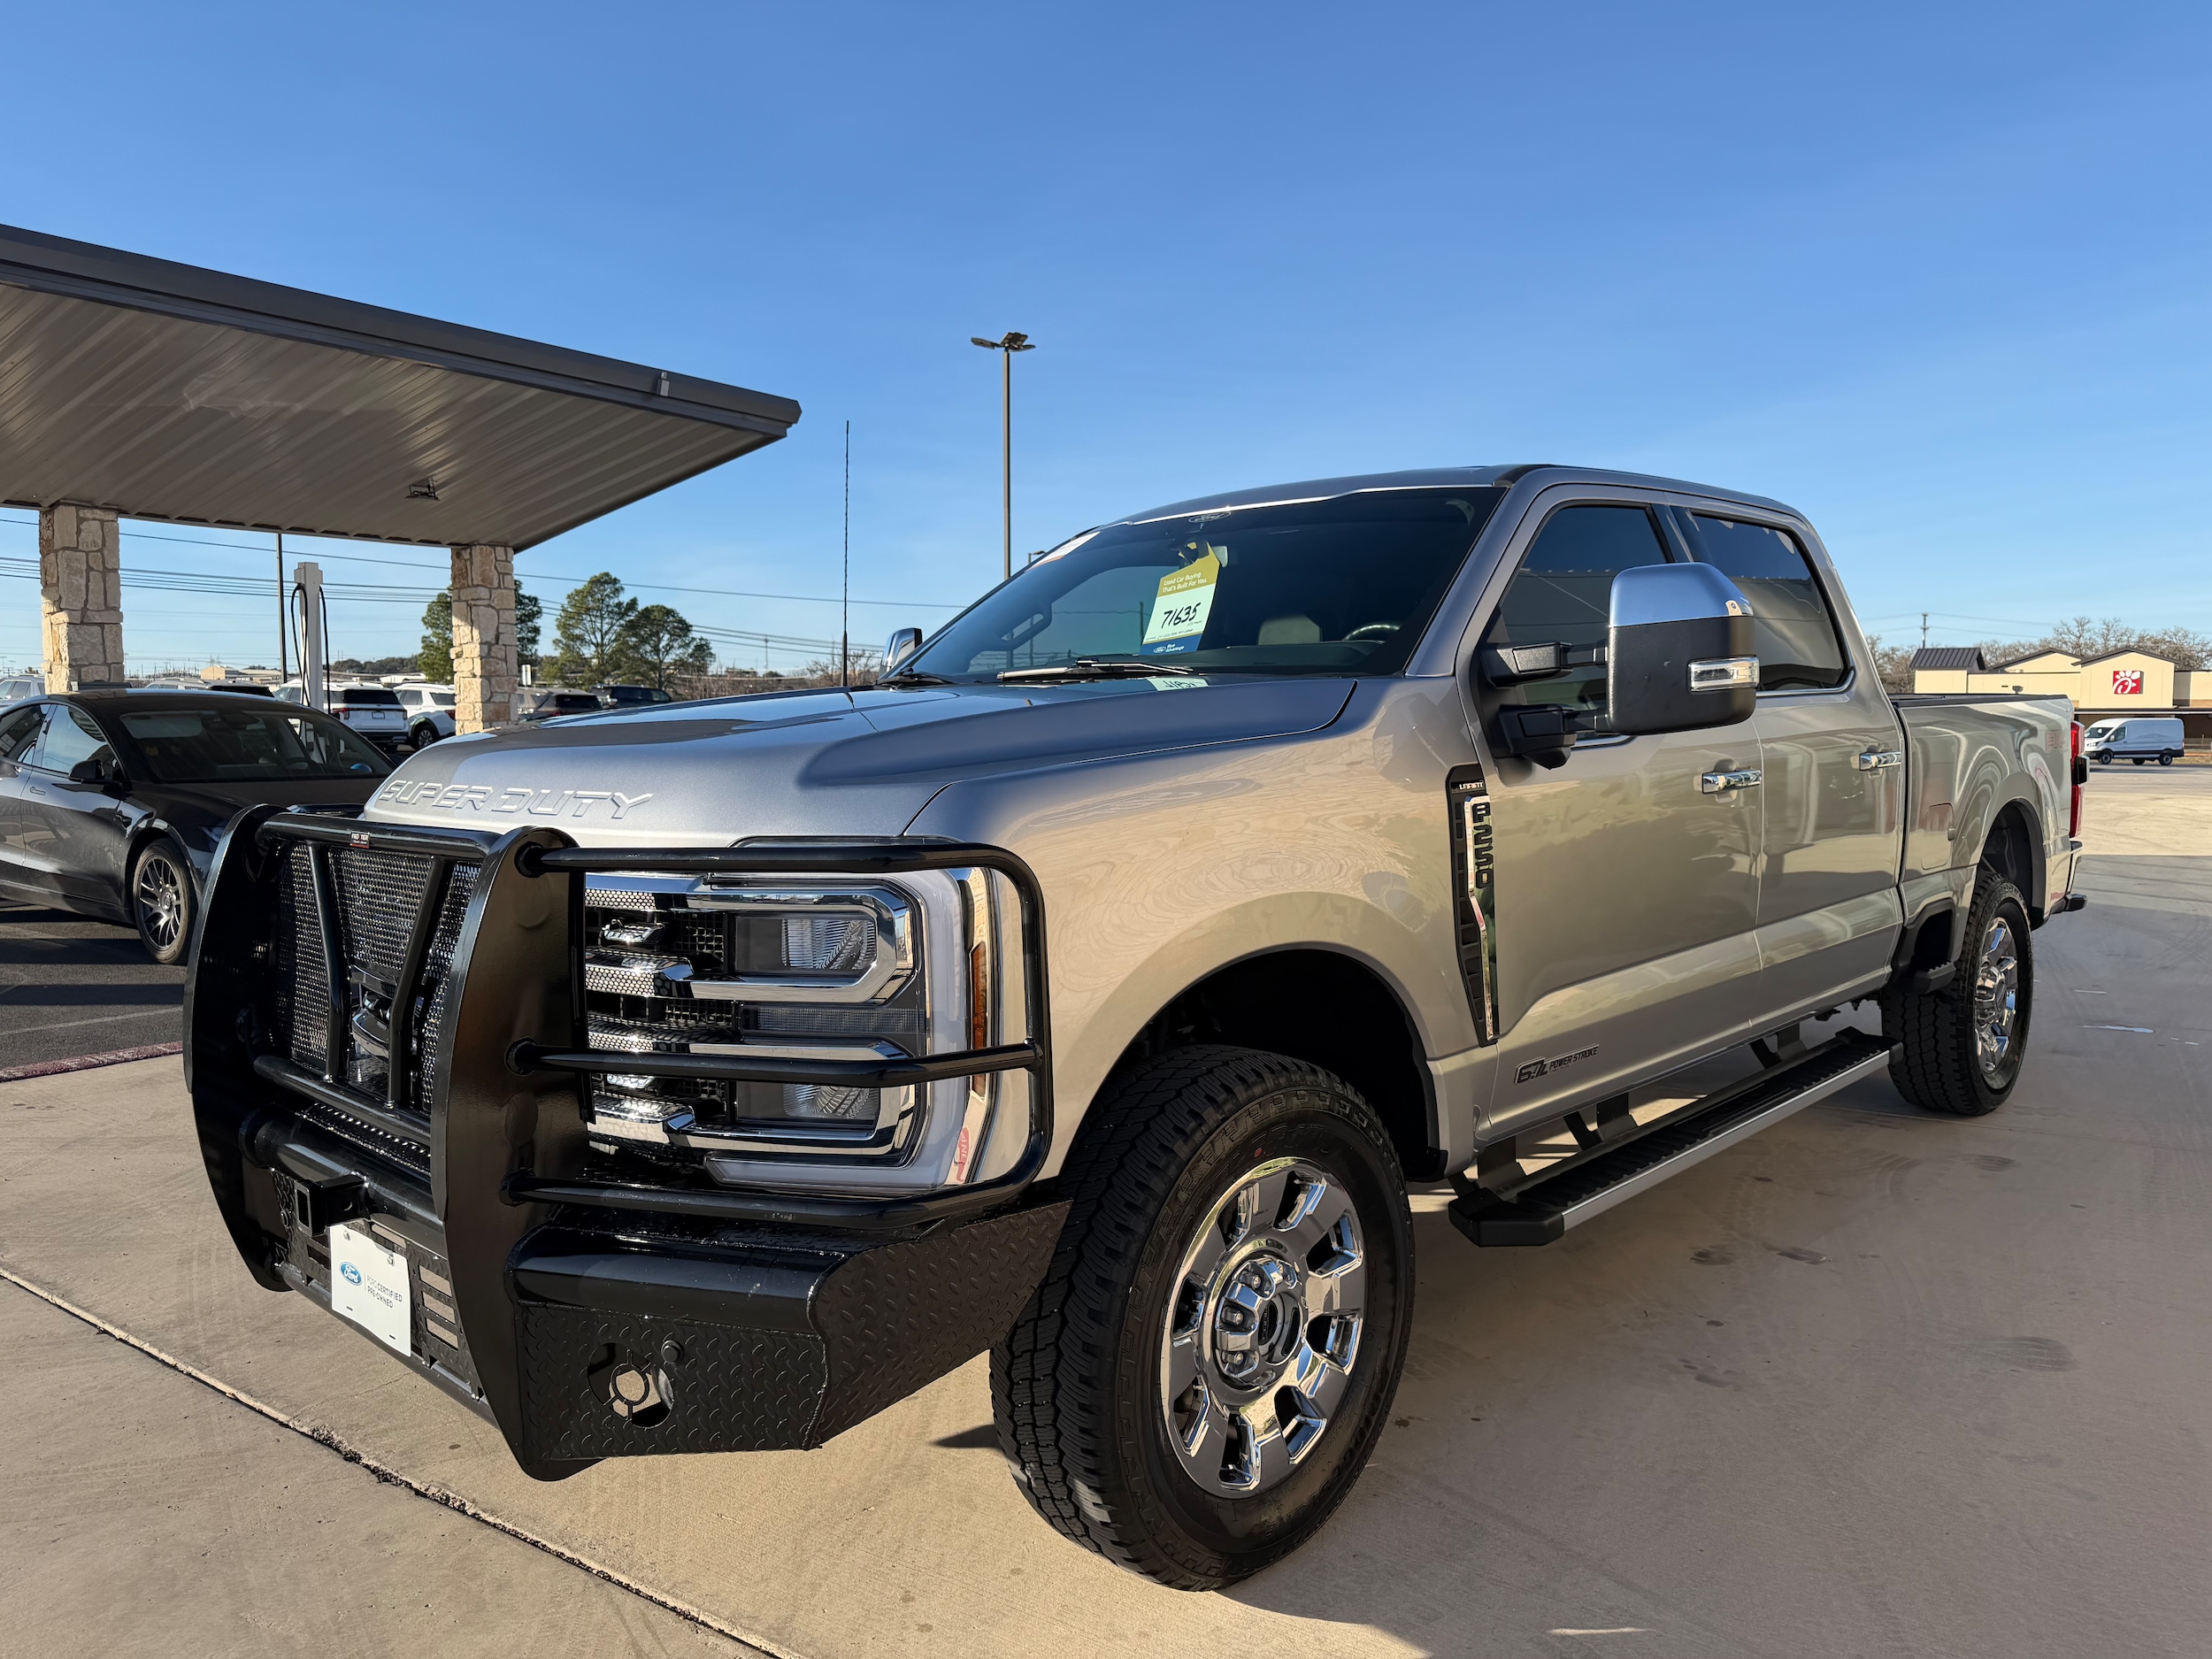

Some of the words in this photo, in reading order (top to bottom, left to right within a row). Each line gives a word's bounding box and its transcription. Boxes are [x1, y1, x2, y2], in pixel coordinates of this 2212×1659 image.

[1161, 603, 1202, 628] 71635
[379, 780, 495, 810] SUPER
[490, 787, 654, 819] DUTY
[1548, 1056, 1573, 1071] POWER
[1573, 1046, 1599, 1063] STROKE
[342, 1263, 360, 1284] Ford
[367, 1285, 394, 1309] PRE-OWNED
[377, 1283, 403, 1302] CERTIFIED
